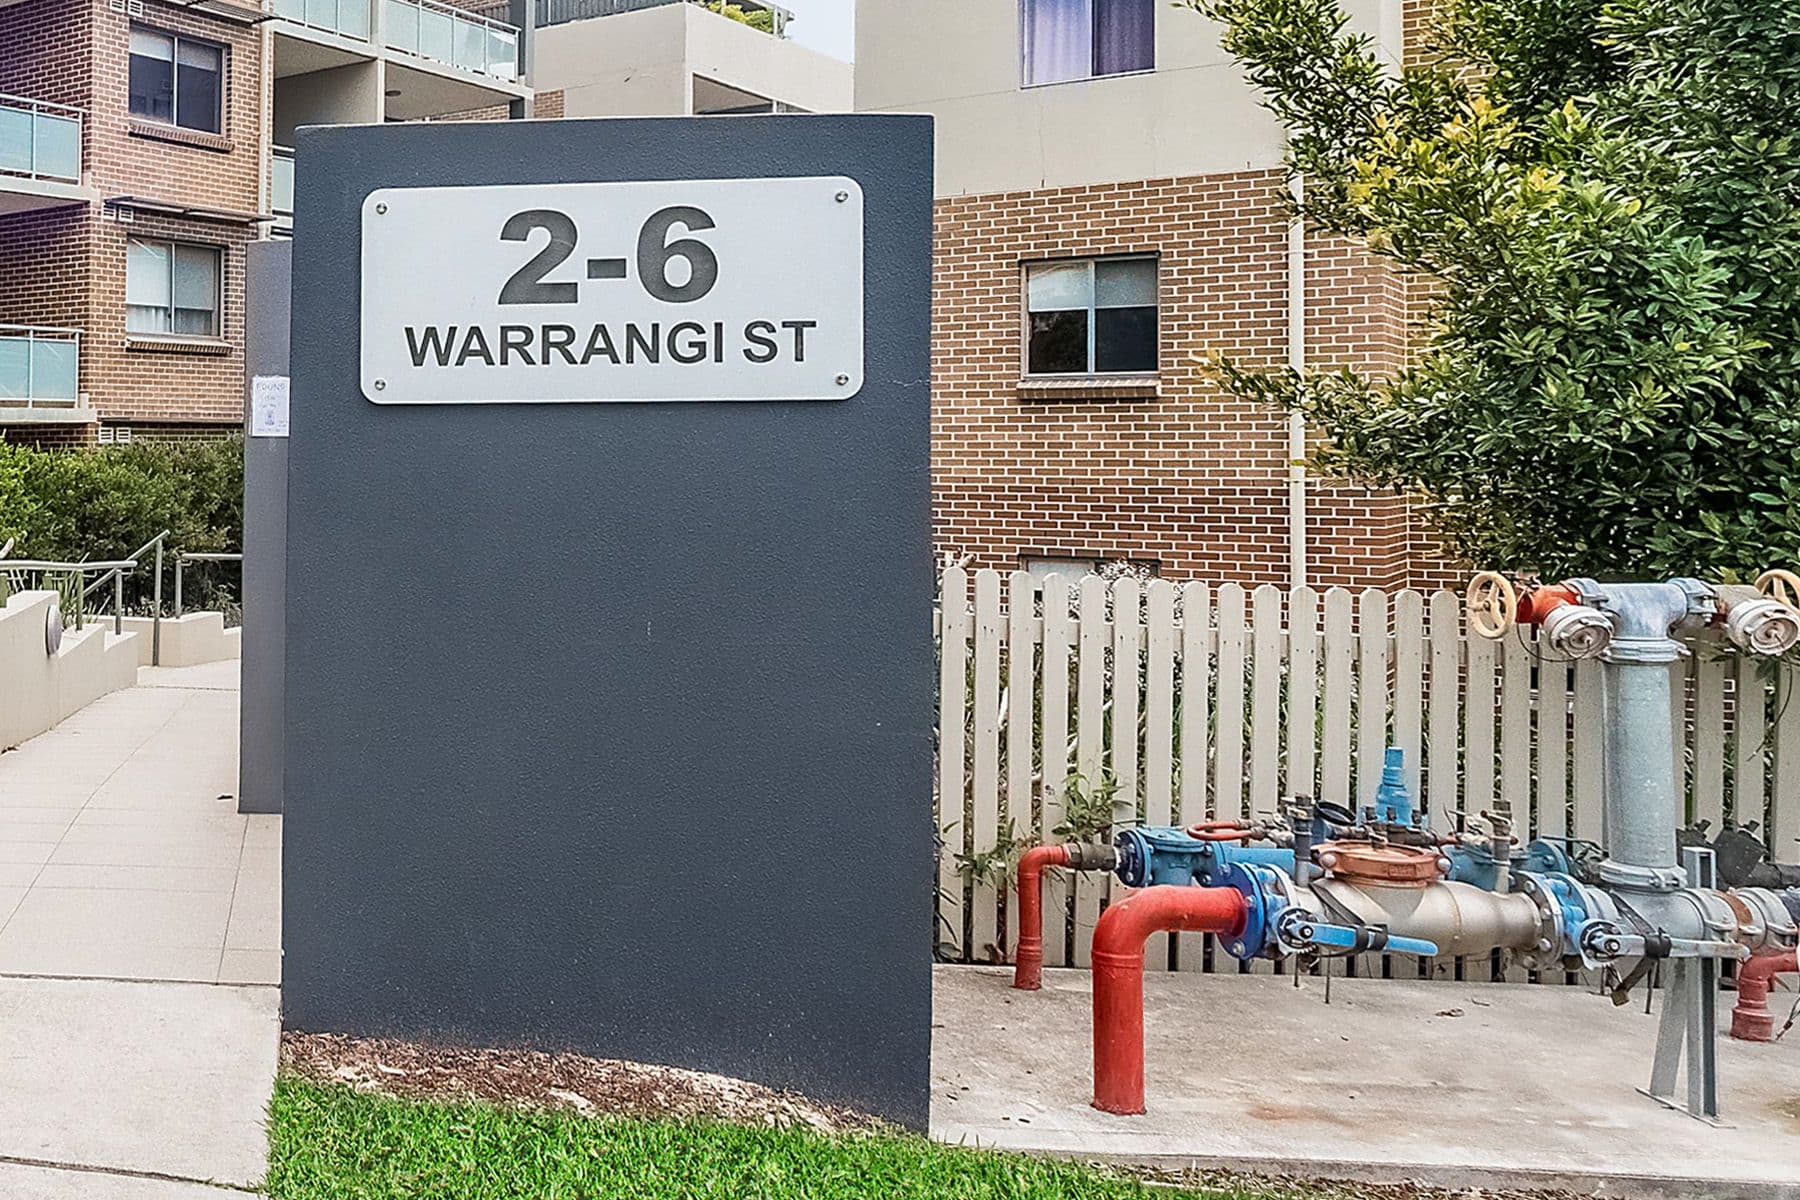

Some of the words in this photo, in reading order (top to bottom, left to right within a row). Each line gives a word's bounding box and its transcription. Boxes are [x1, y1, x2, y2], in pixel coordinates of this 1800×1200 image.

[497, 205, 719, 306] 2-6
[404, 321, 724, 367] WARRANGI
[742, 320, 817, 364] ST
